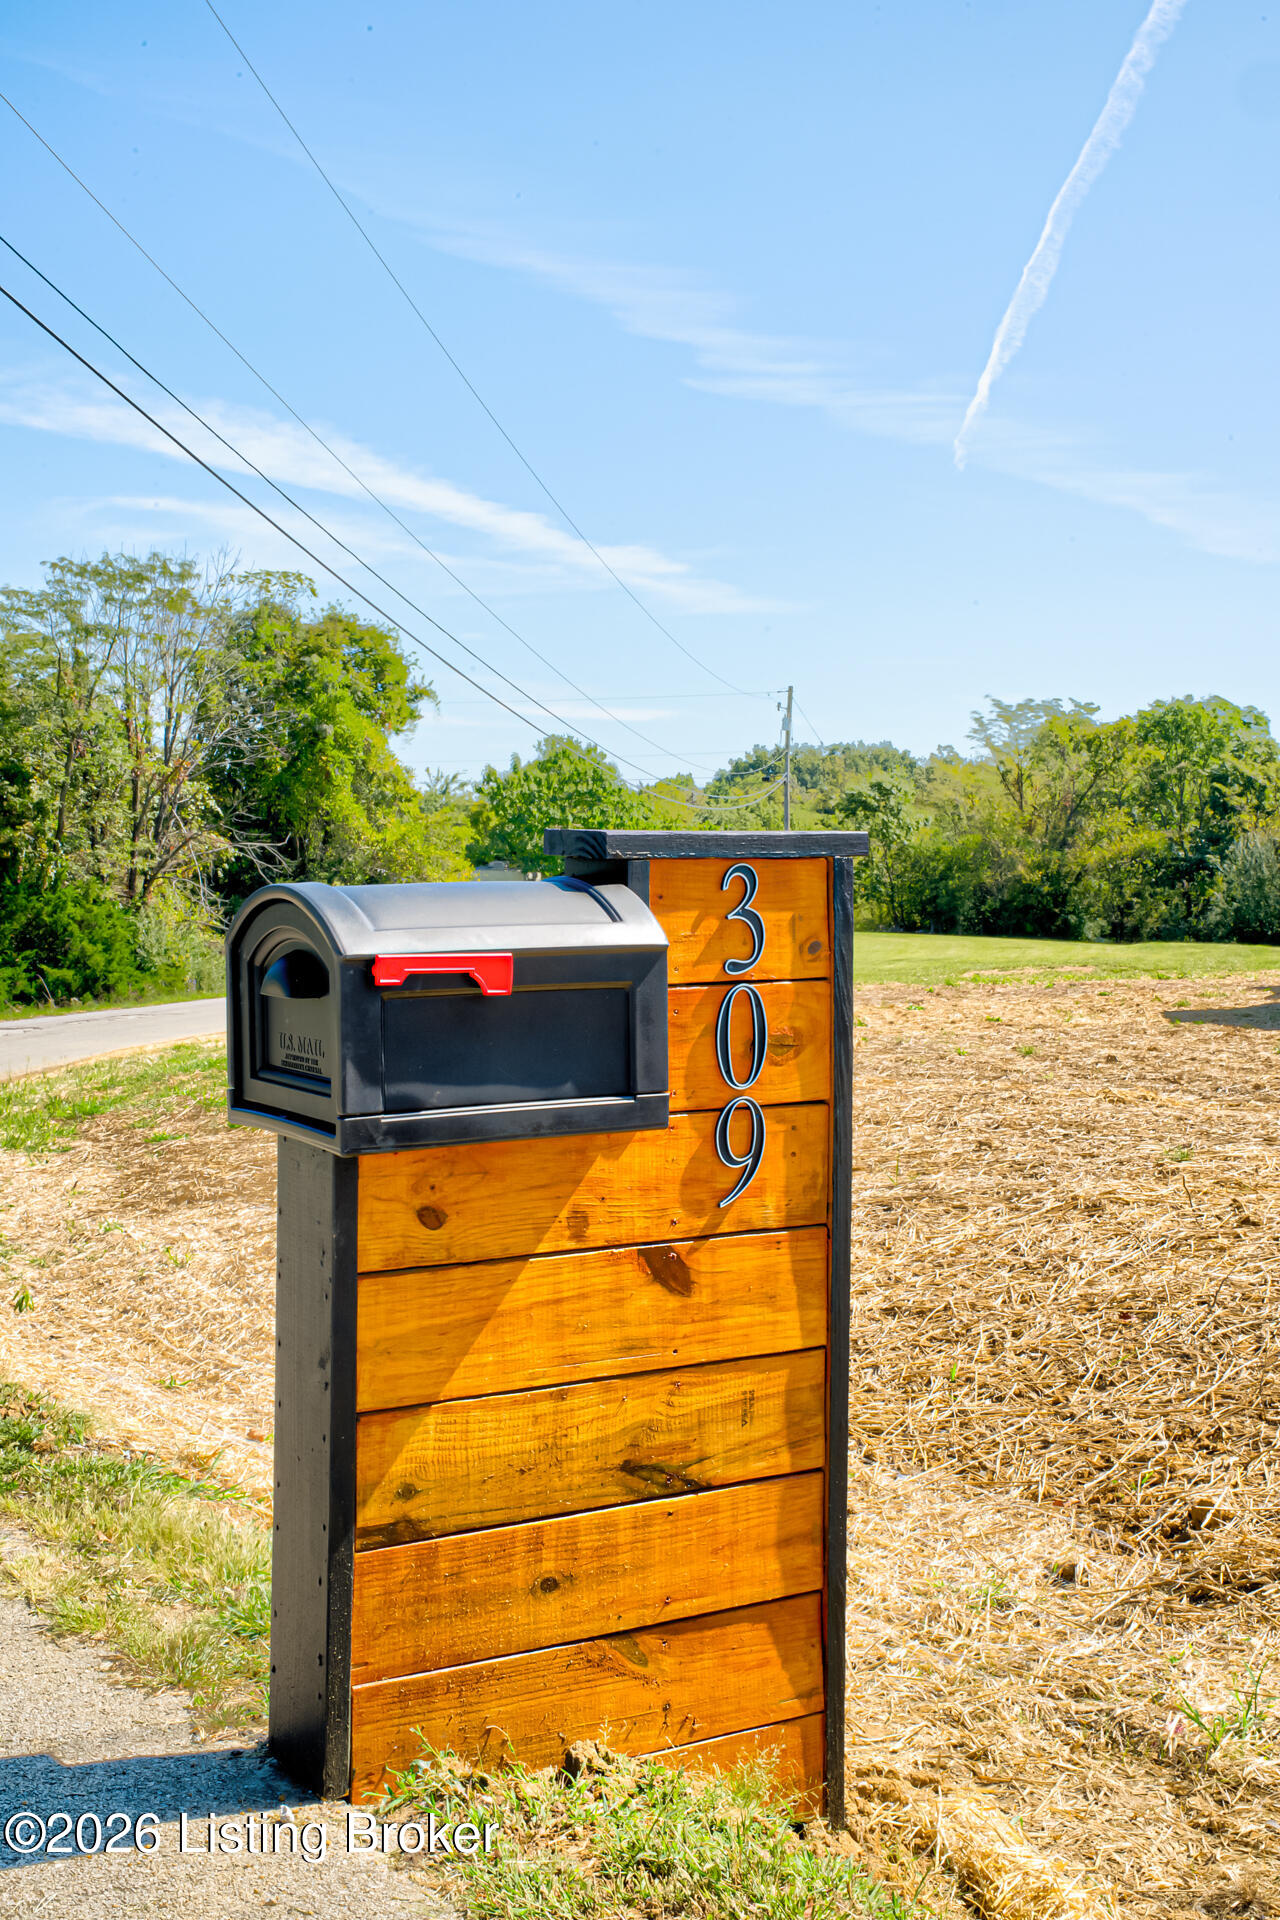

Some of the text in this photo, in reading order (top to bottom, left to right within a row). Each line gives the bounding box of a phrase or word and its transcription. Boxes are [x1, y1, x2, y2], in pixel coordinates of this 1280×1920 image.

[279, 1031, 296, 1052] U.S.
[298, 1035, 325, 1059] MAIL
[715, 863, 768, 1208] 309
